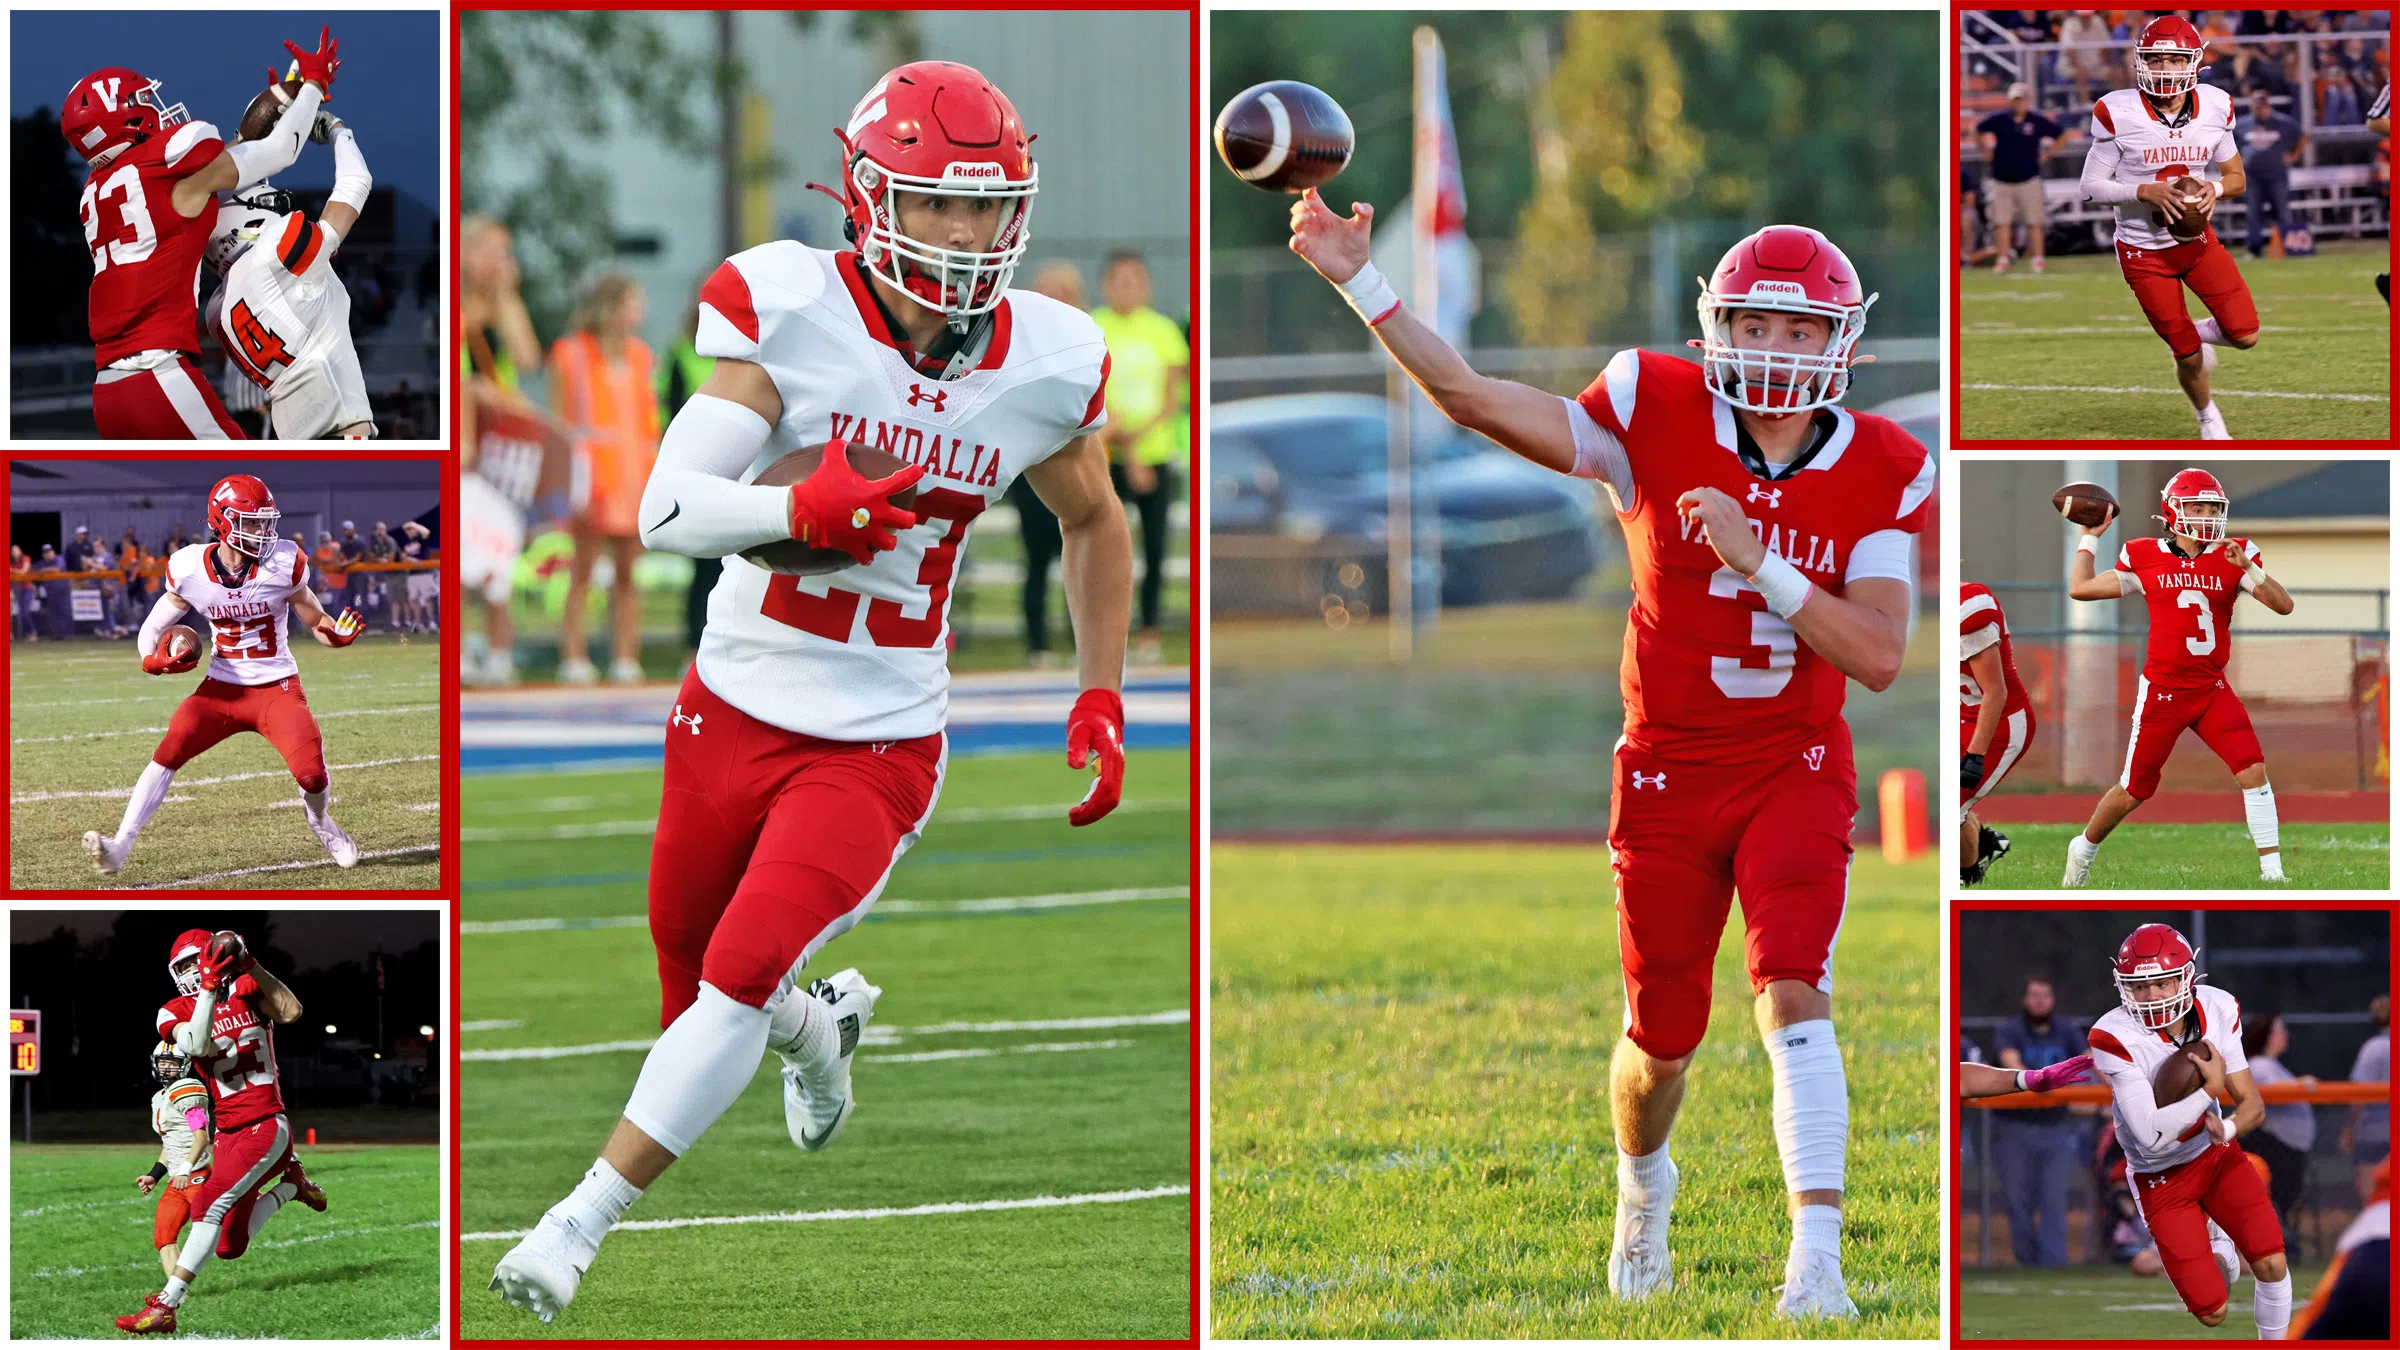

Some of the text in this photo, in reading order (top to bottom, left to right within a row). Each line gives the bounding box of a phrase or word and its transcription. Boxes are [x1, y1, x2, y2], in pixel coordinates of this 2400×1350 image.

[91, 77, 121, 112] V
[953, 166, 999, 177] Riddell
[2143, 146, 2209, 164] VANDALIA
[80, 164, 157, 276] 23
[997, 212, 1025, 250] Riddell
[831, 412, 1001, 487] VANDALIA
[213, 481, 234, 506] V
[1679, 514, 1836, 574] VADALIA
[2157, 573, 2223, 590] VANDALIA
[207, 601, 271, 618] VANDALIA
[2177, 589, 2216, 655] 3
[211, 615, 277, 659] 23
[1708, 565, 1798, 698] 3
[211, 1010, 260, 1037] ANDALIA
[17, 1043, 36, 1070] 10
[213, 1026, 275, 1099] 23
